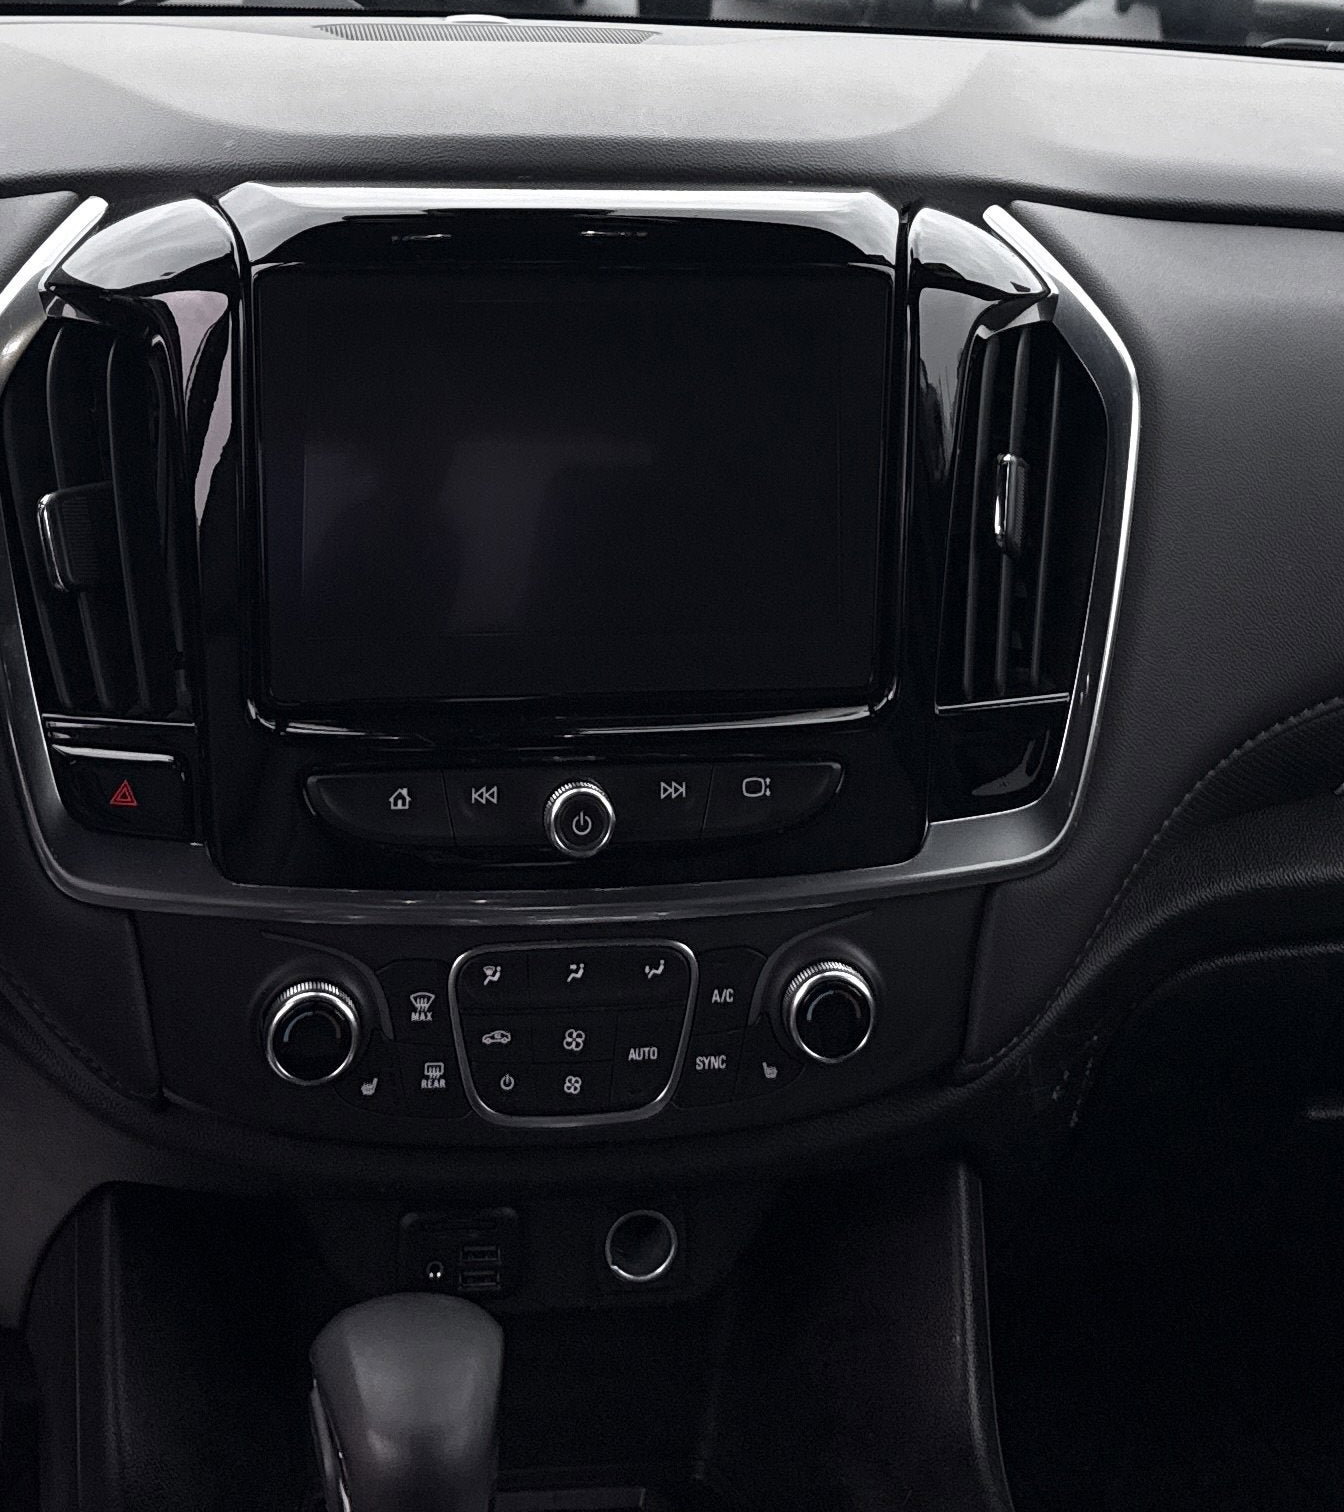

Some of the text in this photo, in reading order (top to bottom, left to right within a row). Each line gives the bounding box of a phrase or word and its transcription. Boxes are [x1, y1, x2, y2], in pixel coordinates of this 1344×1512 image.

[712, 988, 734, 1003] A/C
[411, 1011, 432, 1021] MAX
[628, 1047, 658, 1061] AUTO
[696, 1055, 727, 1070] SYNC
[421, 1078, 446, 1089] REAR
